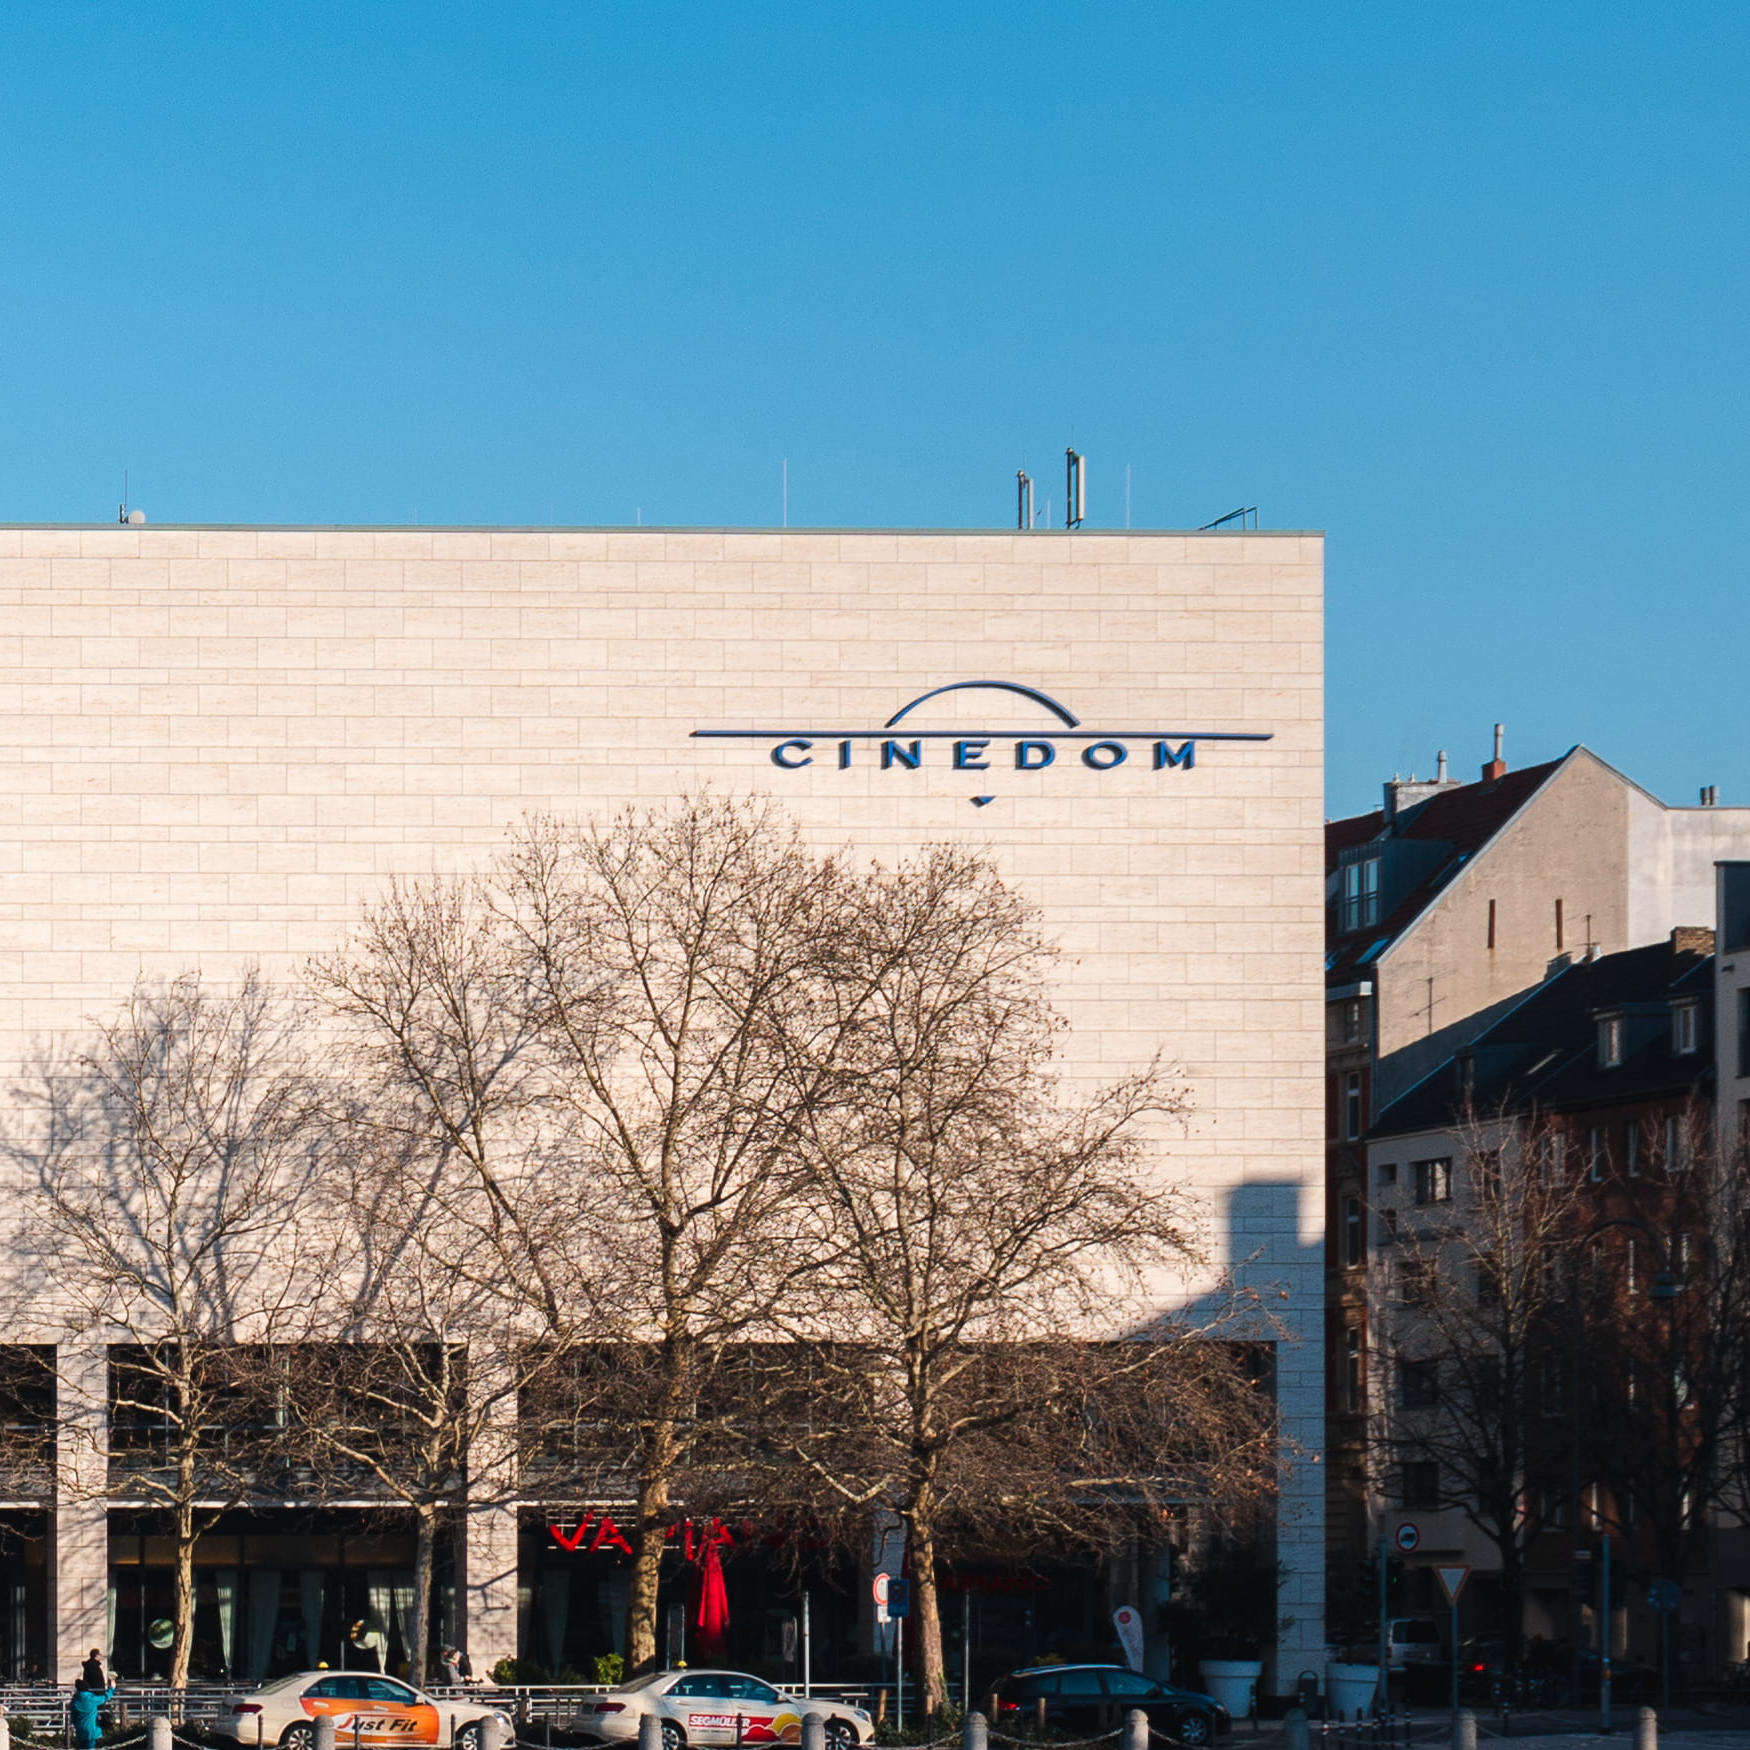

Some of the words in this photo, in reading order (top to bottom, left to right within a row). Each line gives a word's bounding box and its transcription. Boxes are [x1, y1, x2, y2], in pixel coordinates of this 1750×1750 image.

[771, 739, 1196, 772] CINEDOM
[389, 1718, 418, 1732] Fit
[690, 1715, 751, 1727] SEGMÜLLR
